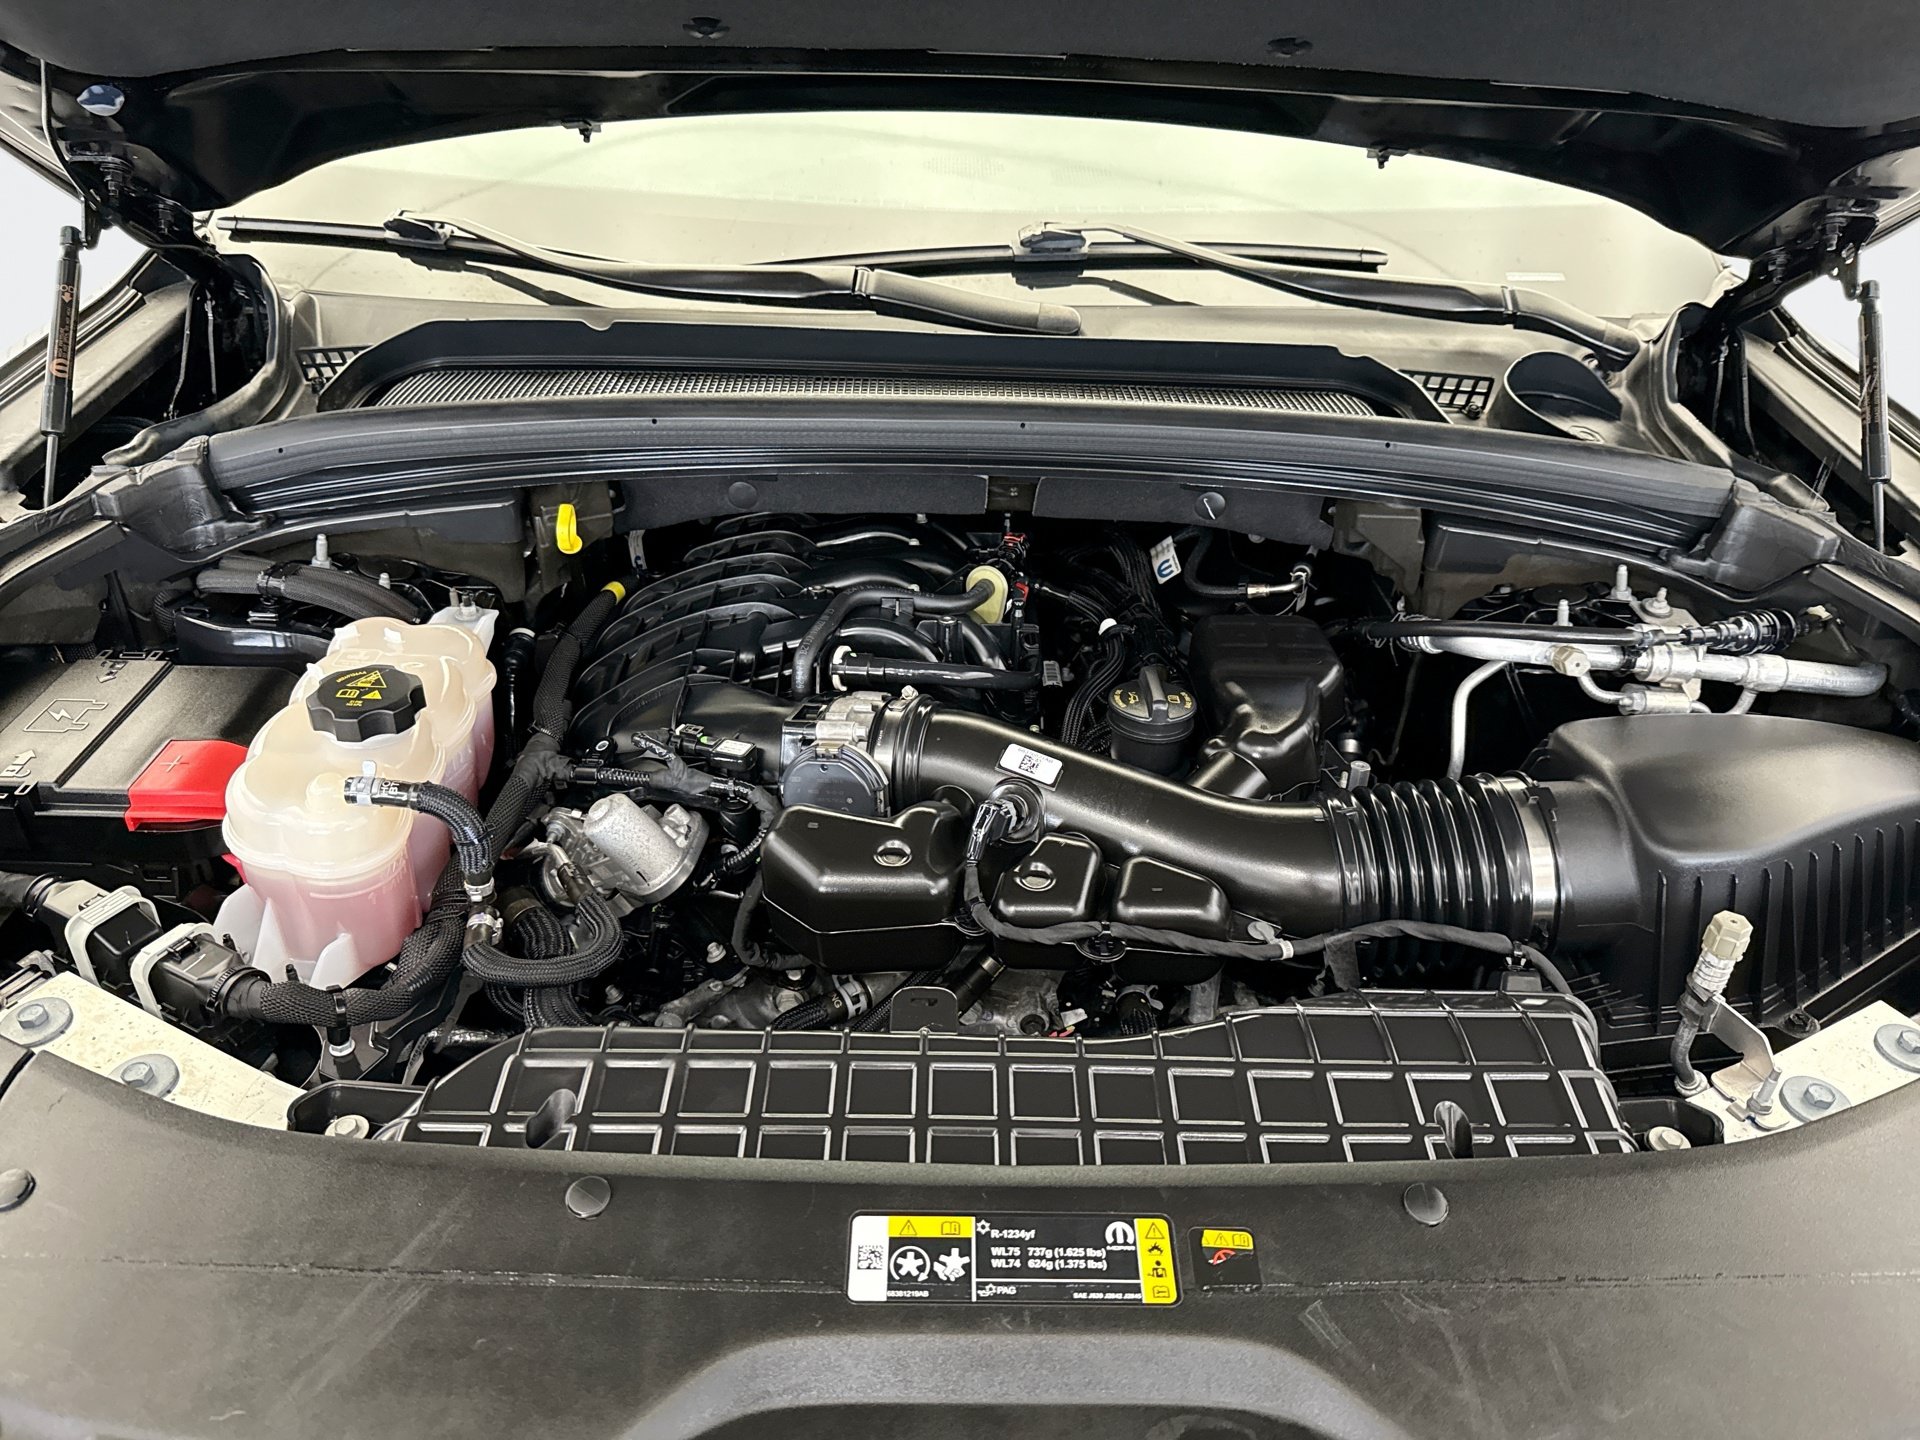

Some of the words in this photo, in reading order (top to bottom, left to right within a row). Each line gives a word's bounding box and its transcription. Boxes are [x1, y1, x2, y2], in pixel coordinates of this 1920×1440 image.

[990, 1229, 1036, 1241] R-1234yf
[990, 1247, 1021, 1257] WL75
[1027, 1247, 1053, 1258] 737g
[1054, 1247, 1085, 1259] (1.625
[1086, 1248, 1107, 1259] lbs)
[991, 1259, 1021, 1268] WL74
[1027, 1259, 1054, 1270] 624g
[1054, 1259, 1086, 1271] (1.375
[1087, 1260, 1108, 1271] lbs)
[997, 1286, 1017, 1295] PAG
